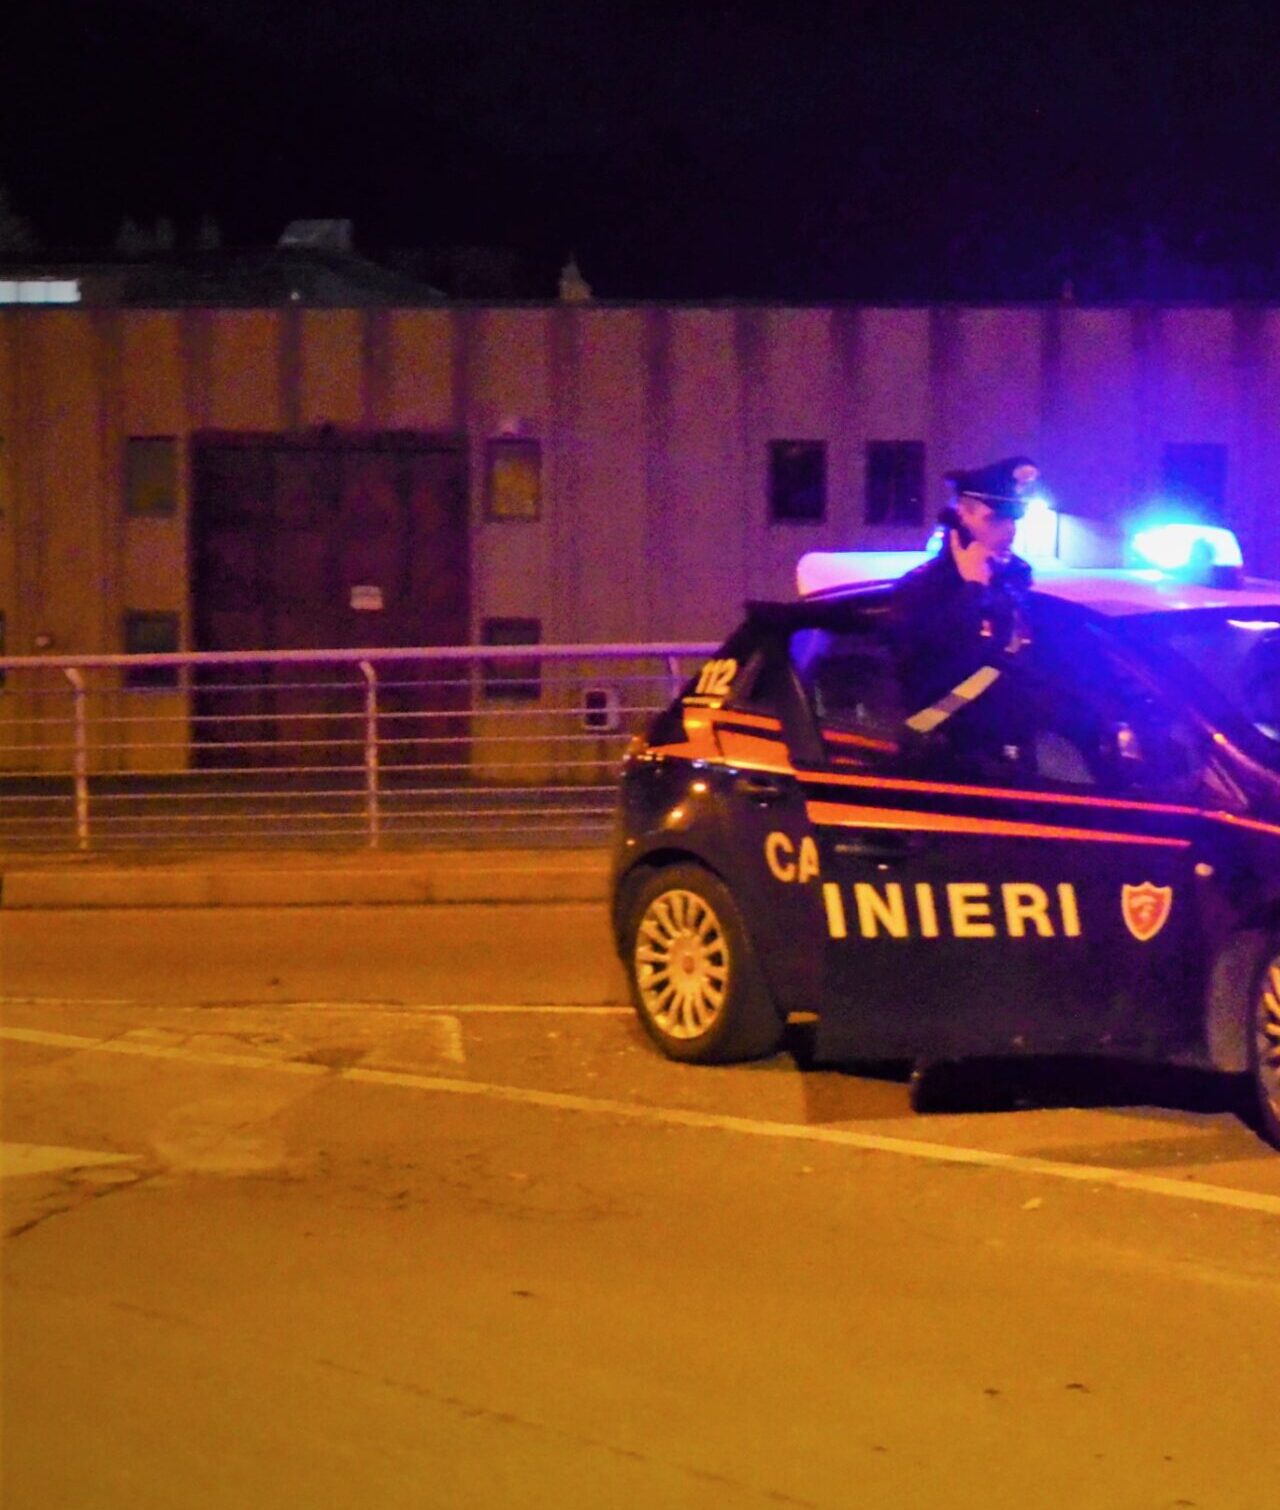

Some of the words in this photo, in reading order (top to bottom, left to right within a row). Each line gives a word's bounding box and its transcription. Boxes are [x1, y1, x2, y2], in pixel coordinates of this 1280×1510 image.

[696, 658, 737, 695] 112
[765, 831, 820, 884] CA
[822, 882, 1081, 939] INIERI
